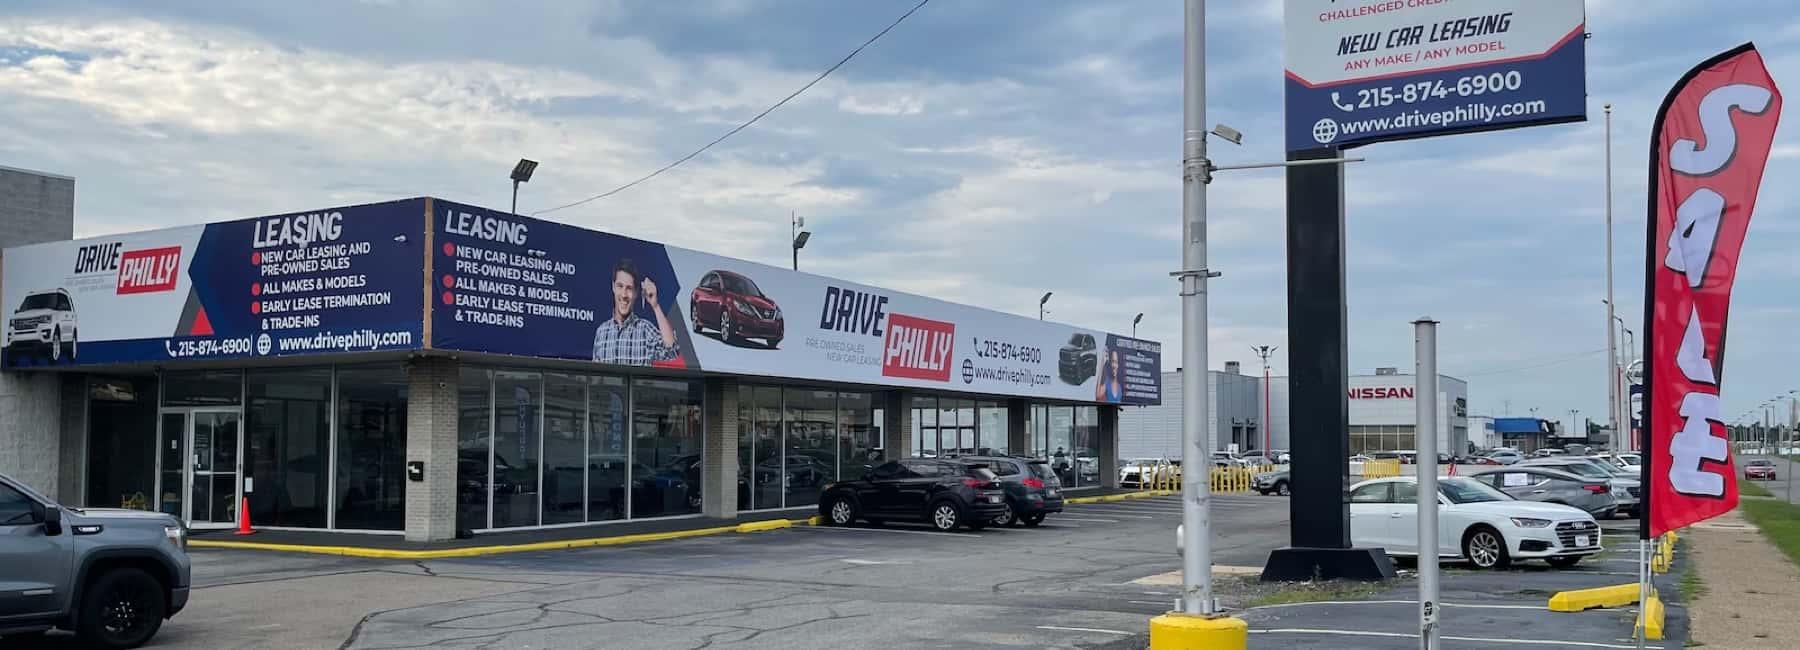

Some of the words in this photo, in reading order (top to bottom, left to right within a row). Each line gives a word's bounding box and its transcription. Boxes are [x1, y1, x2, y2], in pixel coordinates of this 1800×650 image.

[1319, 1, 1404, 22] CHALLENGED
[1337, 32, 1381, 56] NEW
[1386, 25, 1424, 49] CAR
[1429, 12, 1513, 43] LEASING
[1344, 58, 1372, 71] ANY
[1375, 52, 1413, 67] MAKE
[1424, 48, 1452, 61] ANY
[1456, 40, 1507, 56] MODEL
[1358, 70, 1522, 109] 215-874-6900
[1341, 100, 1546, 134] www.drivephilly.com
[252, 211, 343, 249] LEASING
[445, 210, 529, 245] LEASING
[74, 242, 122, 274] DRIVE
[261, 250, 285, 265] NEW
[286, 248, 306, 261] CAR
[306, 244, 347, 260] LEASING
[348, 242, 371, 256] AND
[261, 260, 319, 276] PRE-OWNED
[320, 257, 350, 271] SALES
[456, 245, 483, 260] NEW
[484, 250, 507, 264] CAR
[509, 253, 552, 271] LEASING
[553, 262, 576, 275] AND
[119, 253, 179, 288] PHILLY
[456, 260, 521, 280] PRE-OWNED
[522, 270, 555, 285] SALES
[262, 282, 280, 295] ALL
[281, 279, 315, 293] MAKES
[316, 278, 324, 290] &
[325, 275, 367, 289] MODELS
[455, 277, 477, 291] ALL
[478, 280, 517, 296] MAKES
[518, 286, 526, 297] &
[528, 287, 569, 303] MODELS
[262, 300, 291, 313] EARLY
[292, 297, 322, 310] LEASE
[323, 292, 391, 308] TERMINATION
[455, 294, 490, 309] EARLY
[492, 298, 525, 314] LEASE
[525, 303, 594, 321] TERMINATION
[819, 286, 889, 337] DRIVE
[261, 318, 269, 330] &
[270, 315, 320, 330] TRADE-INS
[455, 309, 464, 321] &
[465, 310, 525, 328] TRADE-INS
[178, 339, 250, 357] 215-874-6900
[279, 330, 412, 353] www.drivephilly.com
[885, 325, 953, 371] PHILLY
[984, 340, 1041, 364] 215-874-6900
[975, 366, 1051, 387] www.drivephilly.com
